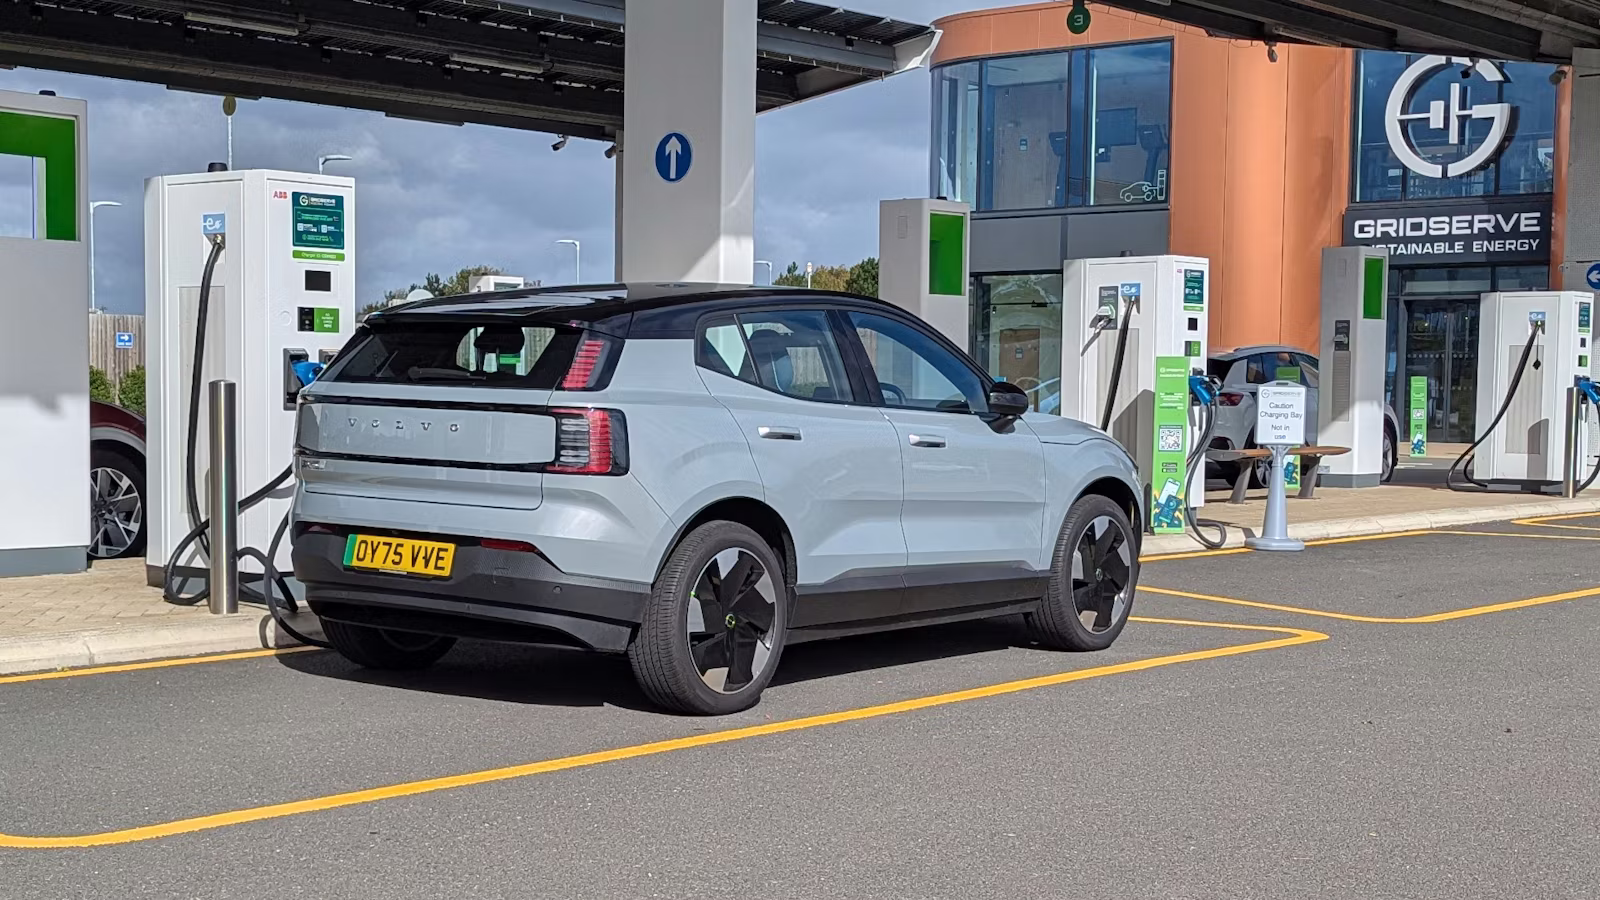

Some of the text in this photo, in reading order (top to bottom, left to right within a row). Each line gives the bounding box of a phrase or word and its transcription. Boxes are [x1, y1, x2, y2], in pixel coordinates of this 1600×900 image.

[1073, 14, 1084, 26] 3
[273, 190, 288, 200] ABB
[1353, 212, 1541, 239] GRIDSERVE
[1371, 239, 1540, 256] TAINABLE ENERGY
[1259, 410, 1303, 420] Charging Bay
[348, 417, 460, 433] VOLVO
[356, 539, 449, 571] OY75 VVE
